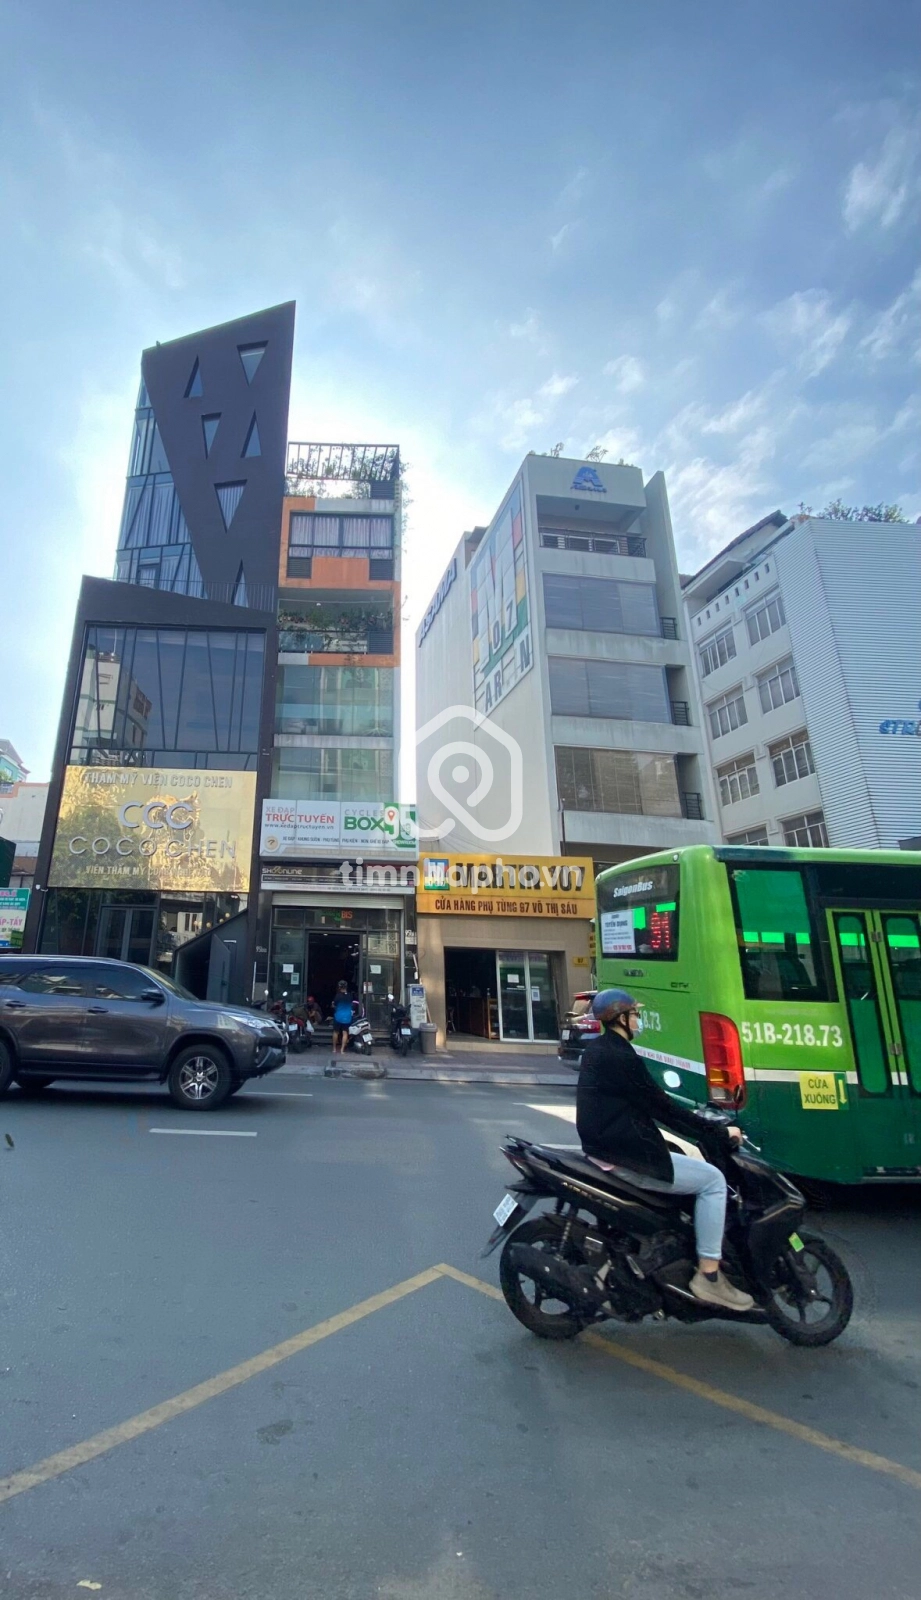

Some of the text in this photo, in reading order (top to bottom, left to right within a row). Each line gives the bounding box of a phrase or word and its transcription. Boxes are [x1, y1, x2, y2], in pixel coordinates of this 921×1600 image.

[170, 774, 200, 788] COCO
[203, 775, 233, 788] CHEN
[120, 802, 193, 829] CCC
[265, 812, 335, 824] TRỰC TUYẾN
[344, 816, 385, 832] BOX
[69, 835, 236, 858] COCO CHEN
[455, 863, 585, 892] MARTIN 107
[613, 881, 653, 898] SaigonBus
[435, 895, 451, 910] CỬA
[454, 897, 476, 911] HÀNG
[477, 901, 493, 914] PHỤ
[496, 898, 517, 912] TÙNG
[532, 900, 543, 914] VÕ
[546, 903, 559, 916] THỊ
[561, 901, 577, 915] SÁU
[742, 1021, 843, 1047] 51B-218.73
[808, 1077, 829, 1089] CỬA
